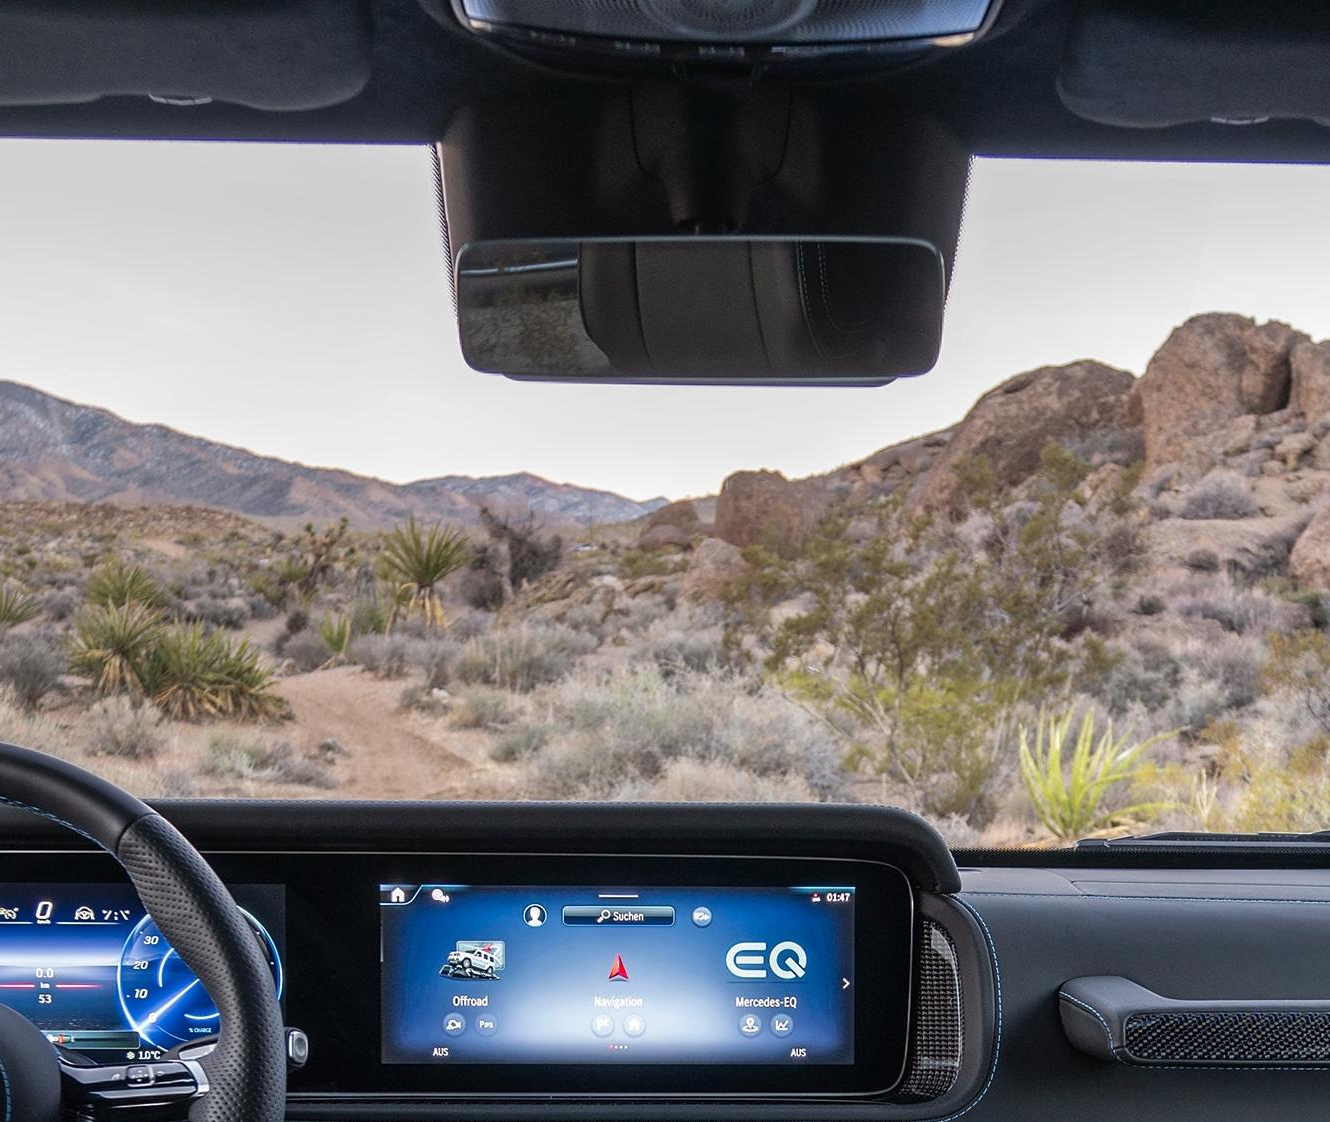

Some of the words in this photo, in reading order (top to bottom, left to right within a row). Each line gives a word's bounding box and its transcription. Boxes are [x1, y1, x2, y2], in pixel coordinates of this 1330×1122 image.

[826, 893, 850, 902] 01:47
[35, 900, 52, 919] 0
[613, 911, 644, 921] Suchen
[143, 935, 159, 945] 30
[133, 960, 148, 970] 20
[725, 941, 807, 979] EQ
[35, 968, 54, 978] 0.0
[134, 988, 148, 999] 10
[38, 994, 52, 1004] 53
[452, 995, 489, 1007] Offroad
[594, 996, 643, 1009] Navigation
[735, 996, 797, 1008] Mercedes-EQ
[432, 1048, 449, 1057] AUS
[790, 1048, 807, 1058] AUS
